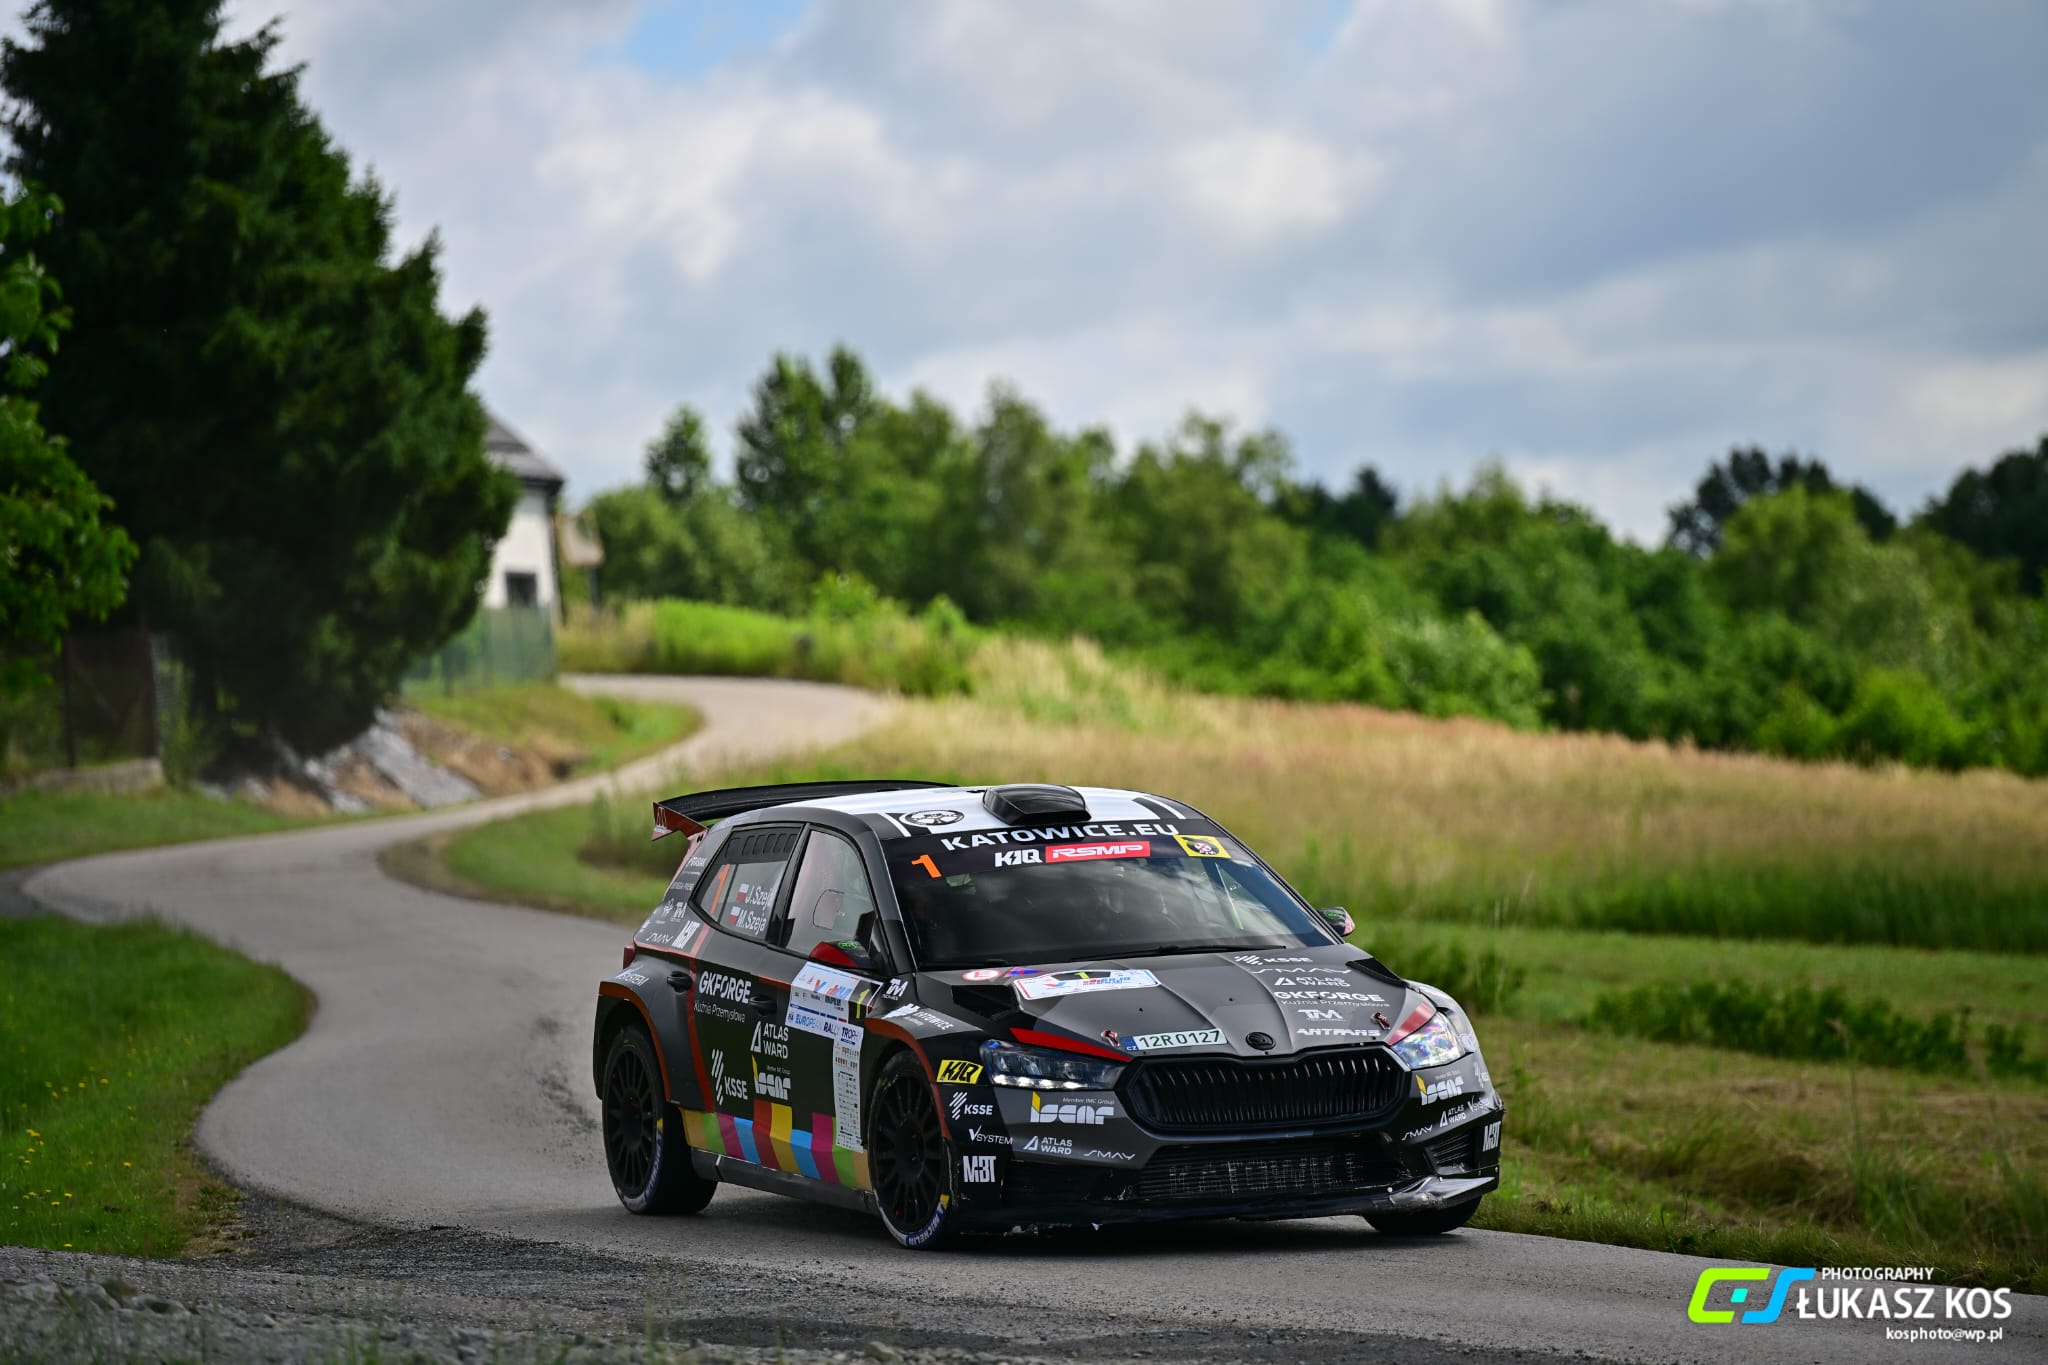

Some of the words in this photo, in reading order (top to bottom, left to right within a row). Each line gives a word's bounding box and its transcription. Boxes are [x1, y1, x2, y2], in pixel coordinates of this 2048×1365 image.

[941, 823, 1179, 850] KATOWICE.EU
[1053, 845, 1143, 859] RSMP
[911, 854, 942, 879] 1
[710, 863, 731, 915] 1
[699, 971, 752, 1004] GKFORGE
[1273, 991, 1385, 1002] GKFORGE
[856, 988, 871, 1019] 1
[763, 1023, 789, 1042] ATLAS
[1139, 1034, 1173, 1048] 12R
[1175, 1030, 1220, 1045] 0127
[763, 1040, 789, 1059] WARD
[724, 1076, 749, 1100] KSSE
[963, 1104, 994, 1115] KSSE
[1041, 1136, 1073, 1148] ATLAS
[1041, 1144, 1072, 1156] WARD
